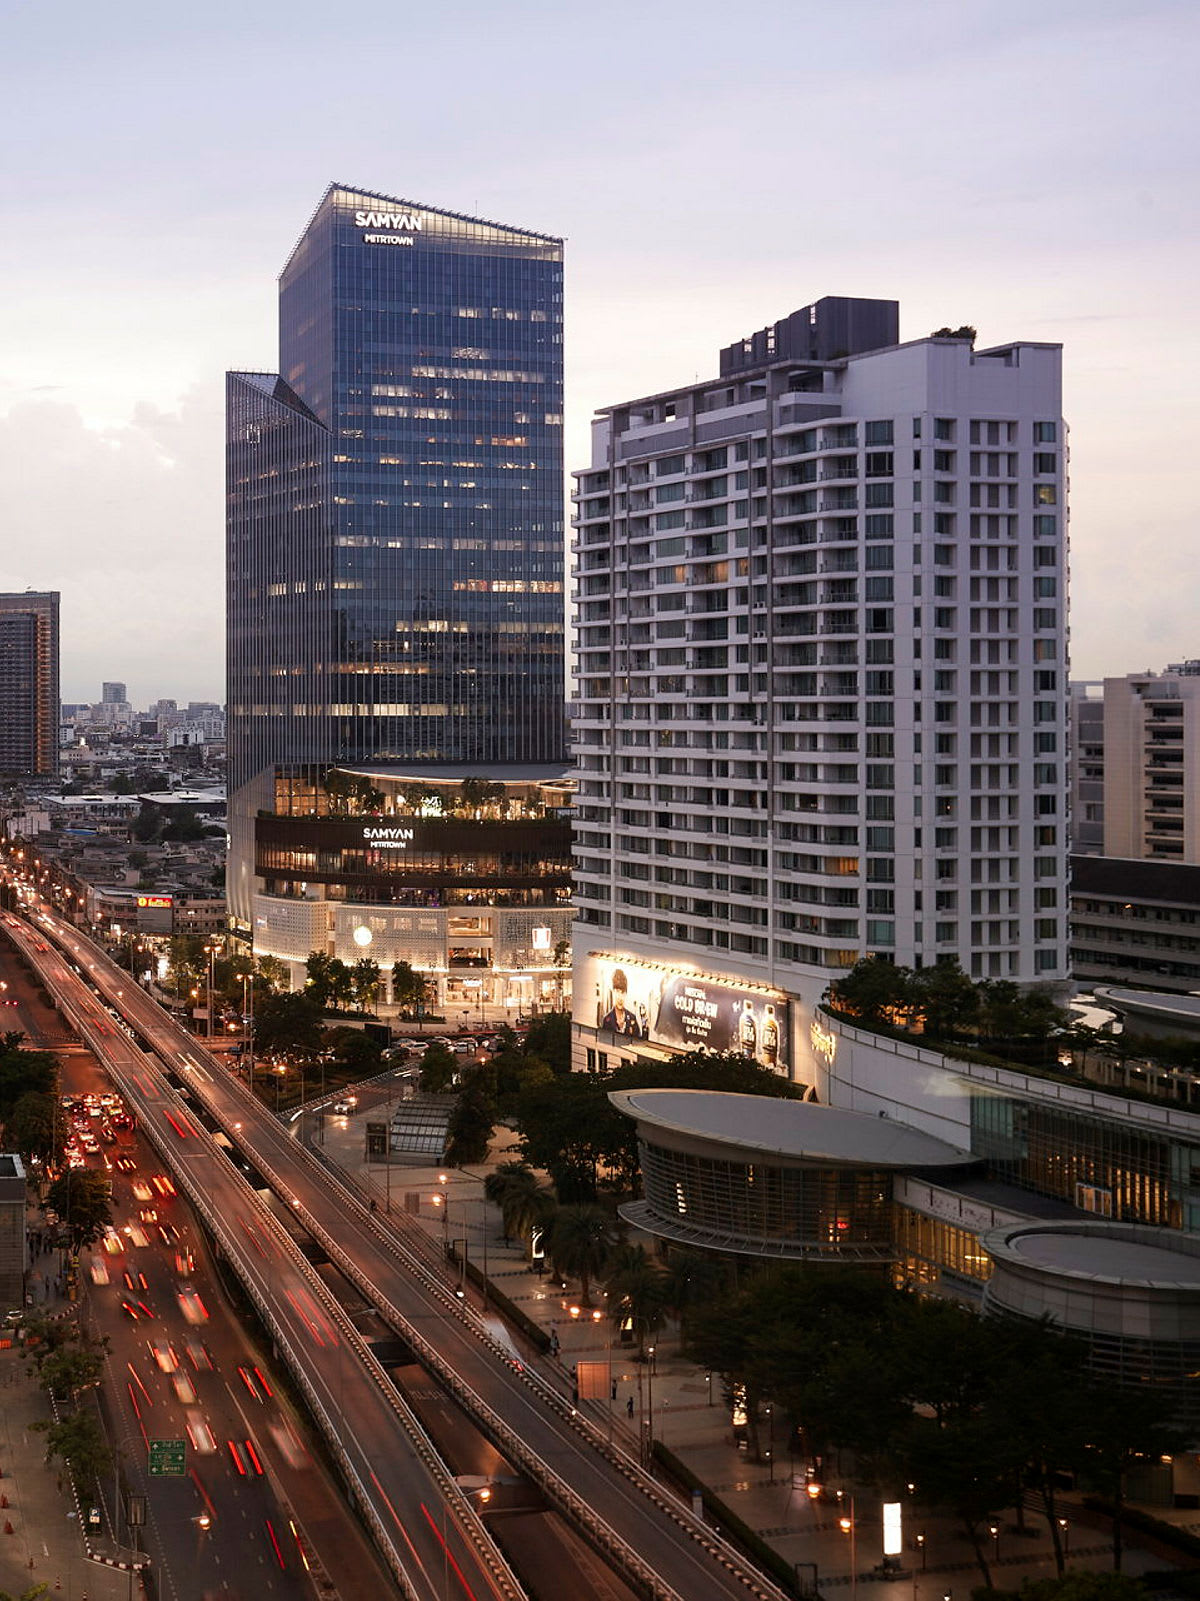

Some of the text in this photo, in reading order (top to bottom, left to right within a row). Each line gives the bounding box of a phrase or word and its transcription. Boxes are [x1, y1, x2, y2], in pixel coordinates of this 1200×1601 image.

[355, 211, 422, 230] SAMYAN
[364, 233, 414, 246] MITRTOWN
[363, 827, 413, 839] SAMYAN
[674, 995, 693, 1012] COLD
